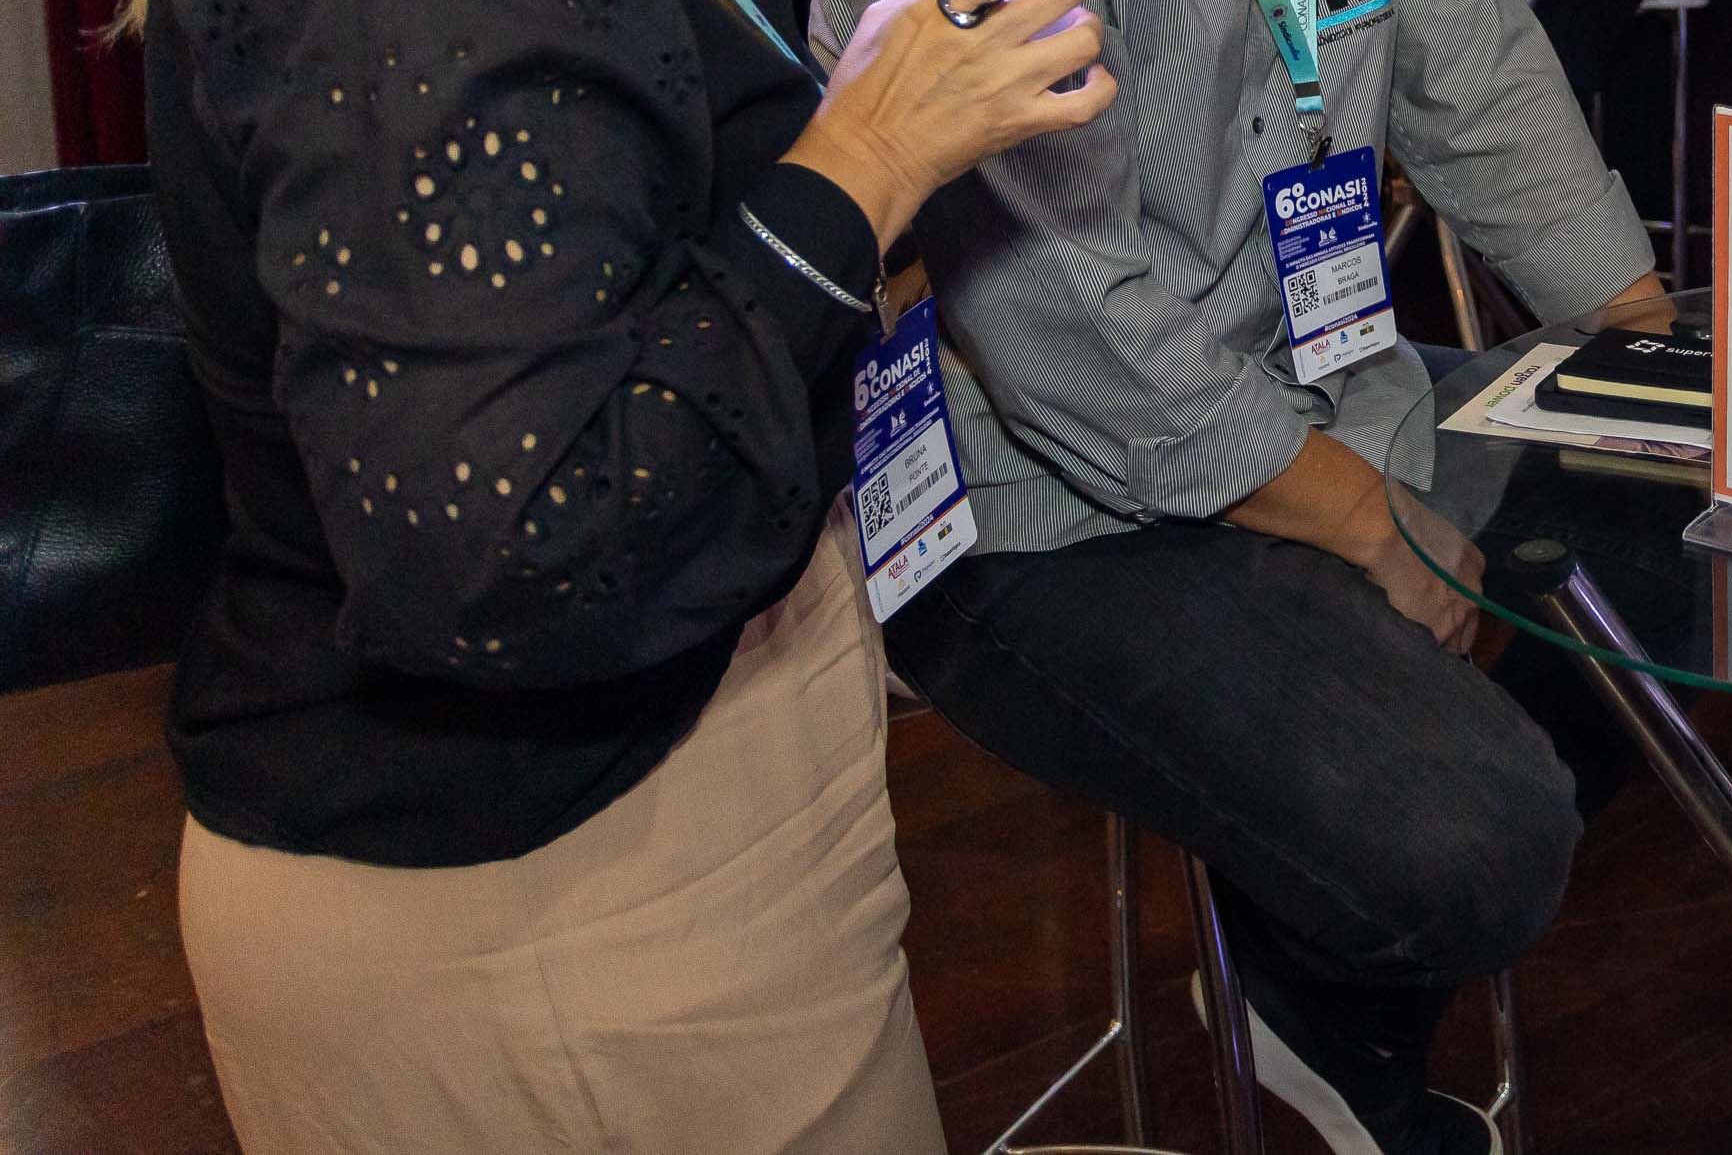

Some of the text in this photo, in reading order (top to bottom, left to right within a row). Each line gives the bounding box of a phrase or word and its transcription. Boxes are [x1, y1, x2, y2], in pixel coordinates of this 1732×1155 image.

[1296, 179, 1360, 213] CONASI
[1361, 177, 1369, 207] 2024
[1331, 256, 1361, 274] MARCOS
[1337, 271, 1360, 285] BRAGA
[1665, 347, 1713, 357] super
[870, 341, 925, 399] CONASI
[905, 444, 927, 469] BRUNA
